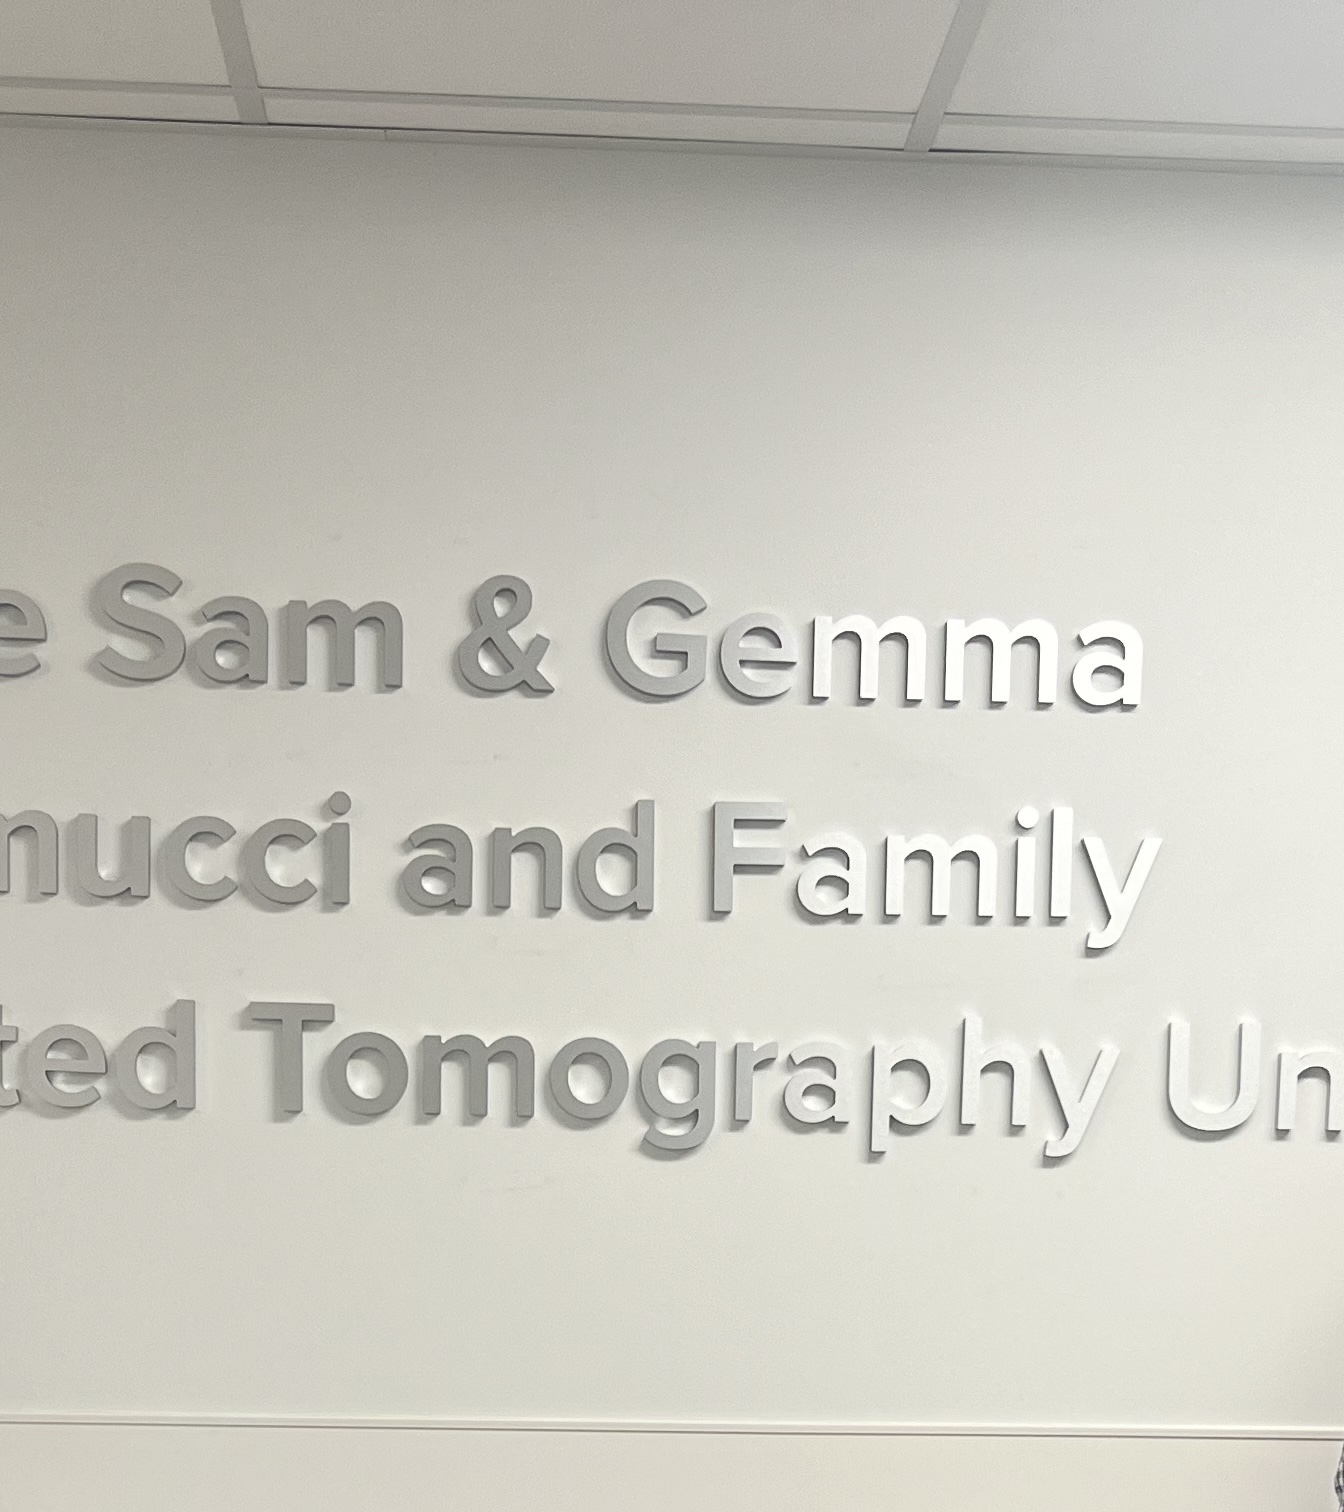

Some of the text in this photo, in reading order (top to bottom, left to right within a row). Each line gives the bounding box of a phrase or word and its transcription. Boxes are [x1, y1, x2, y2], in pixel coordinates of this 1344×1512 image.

[94, 562, 404, 689] Sam
[458, 574, 555, 694] &
[606, 578, 1144, 707] Gemma
[403, 799, 654, 914] and
[712, 801, 1164, 950] Family
[250, 1001, 1121, 1157] Tomography
